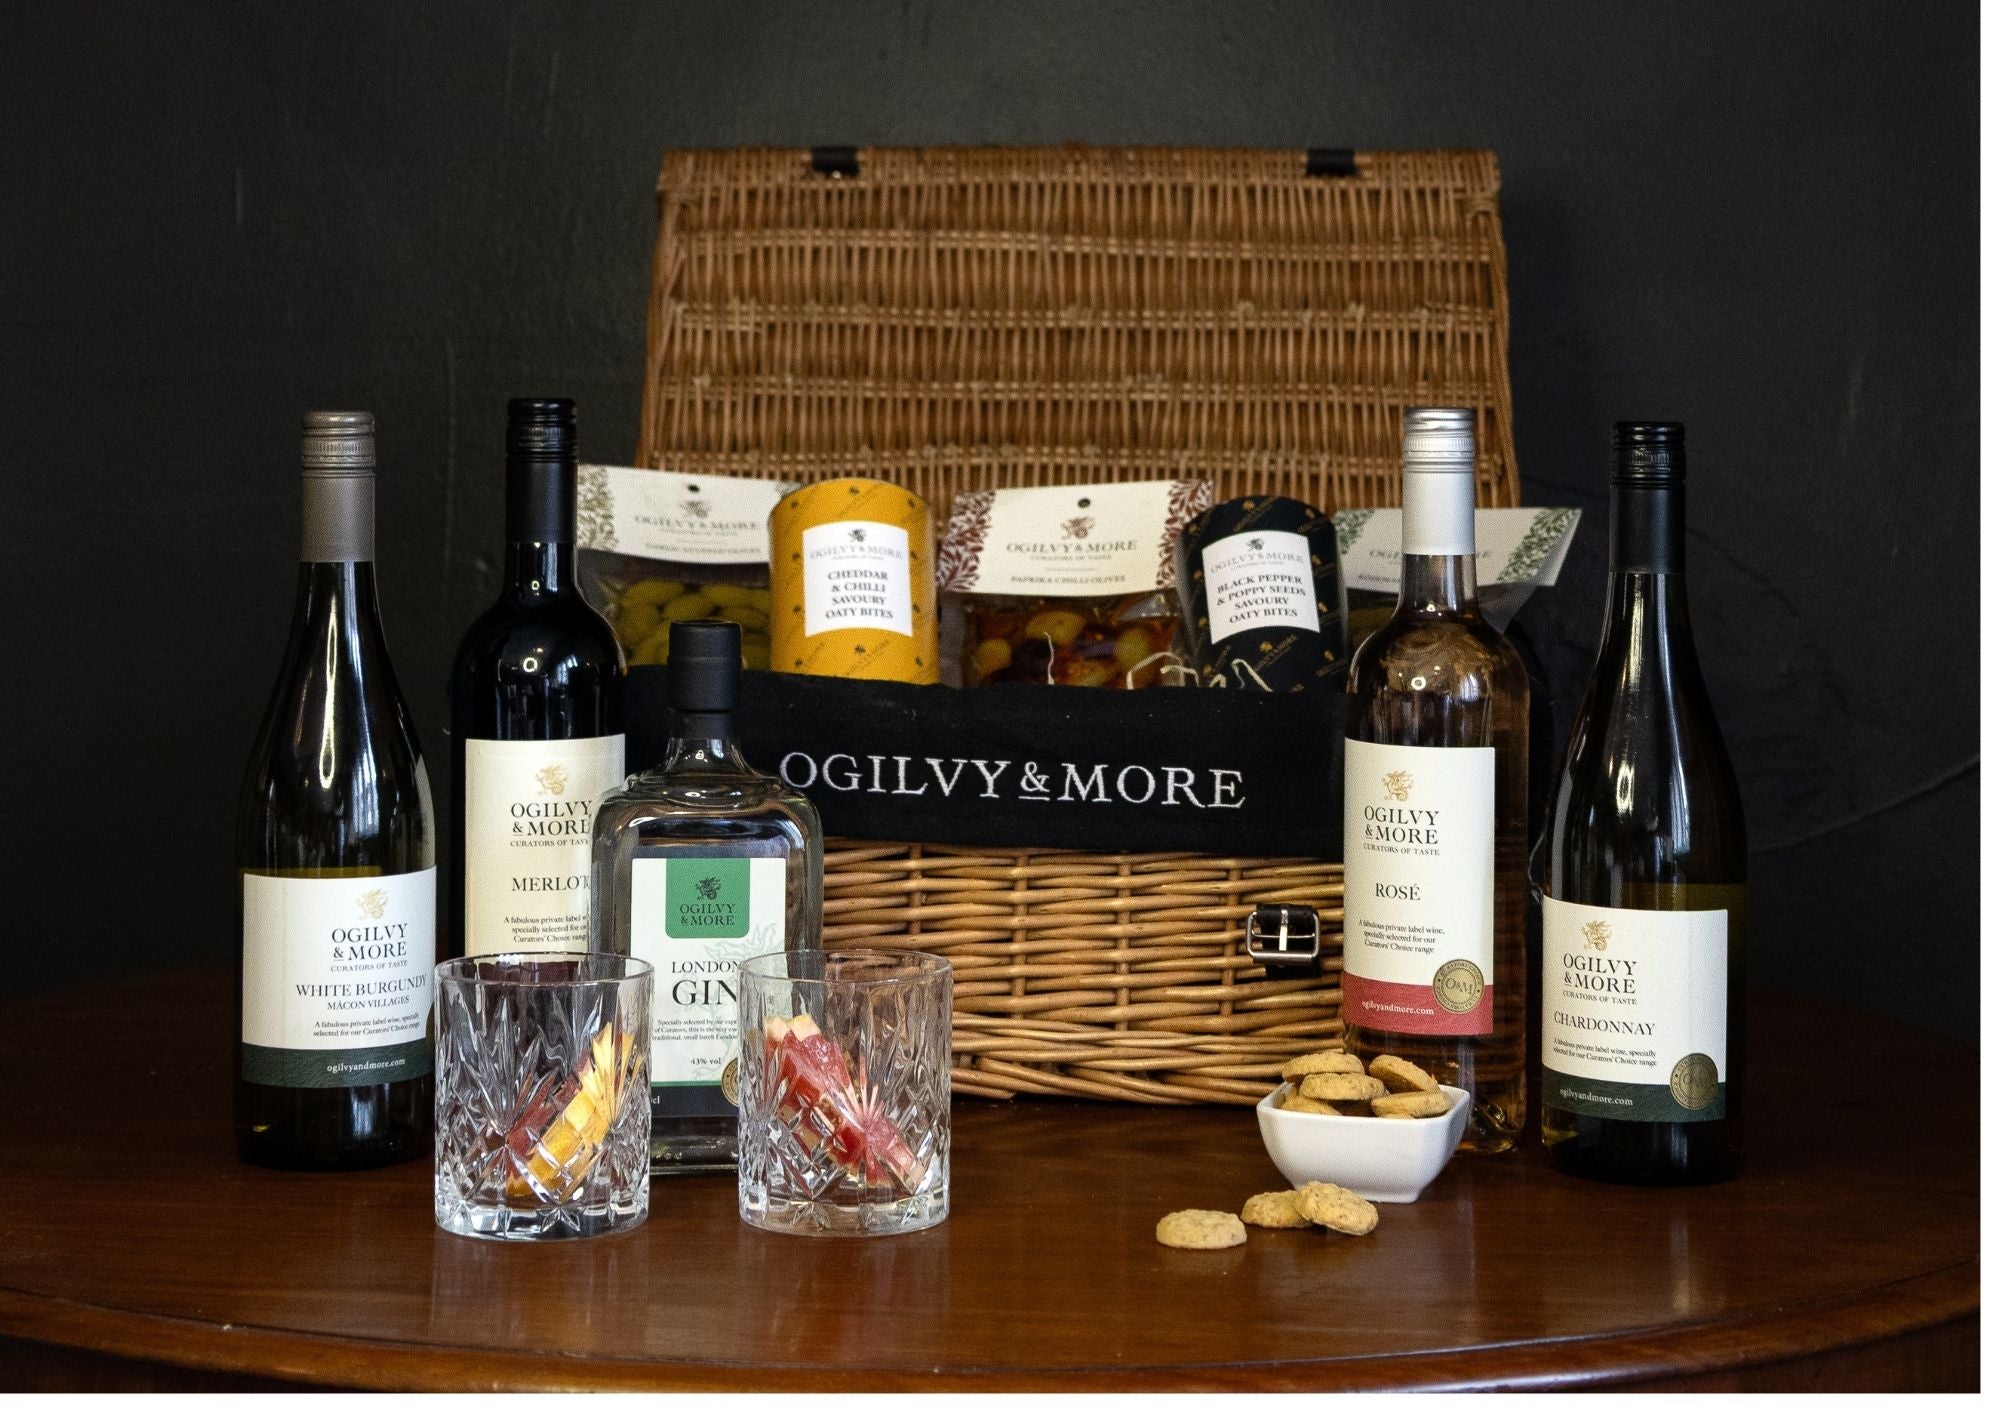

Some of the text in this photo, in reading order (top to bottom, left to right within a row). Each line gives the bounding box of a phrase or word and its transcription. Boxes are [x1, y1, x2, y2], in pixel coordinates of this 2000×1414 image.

[810, 545, 857, 560] OGILVY
[867, 545, 903, 559] MORE
[1006, 543, 1073, 554] OGILVY
[1085, 540, 1138, 553] MORE
[1265, 551, 1305, 564] MORE
[828, 570, 888, 580] CHEDDAR
[832, 583, 886, 592] & CHILLI
[1217, 574, 1303, 594] BLACK PEPPER
[832, 594, 887, 605] SAVOURY
[1216, 585, 1307, 606] & POPPY SEEDS
[1235, 596, 1289, 609] SAVOURY
[826, 607, 894, 619] OATY BITES
[1229, 608, 1298, 624] OATY BITES
[780, 751, 1247, 809] OGILVY & MORE
[510, 800, 593, 818] OGILVY
[1364, 805, 1440, 826] OGILVY
[526, 819, 591, 836] MORE
[1375, 826, 1439, 845] MORE
[510, 838, 590, 848] CURATORS OF TAST
[1363, 843, 1440, 856] CURATORS OF TASTE
[511, 875, 591, 892] MERLOT
[1375, 882, 1421, 902] ROSÉ
[679, 903, 737, 914] OGILVY
[504, 916, 510, 924] A
[511, 916, 540, 924] fabulous
[540, 916, 564, 925] private
[565, 914, 581, 923] label
[690, 915, 735, 926] MORE
[331, 923, 408, 943] OGILVY
[511, 926, 540, 935] specially
[542, 924, 569, 933] selected
[569, 924, 579, 932] for
[1363, 930, 1385, 940] specially
[1386, 933, 1411, 942] selected
[1412, 935, 1422, 943] for
[1385, 924, 1407, 933] private
[1408, 925, 1425, 934] label
[1425, 927, 1445, 936] wine,
[572, 934, 587, 942] rang
[348, 942, 407, 961] MORE
[1390, 942, 1413, 952] Choice
[1414, 946, 1435, 955] range
[330, 960, 408, 973] CURATORS OF TASTE
[672, 960, 740, 974] LONDON
[1563, 953, 1638, 976] OGILVY
[296, 974, 428, 998] WHITE BURGUNDY
[1574, 973, 1636, 994] MORE
[672, 979, 738, 1007] GIN
[1562, 990, 1638, 1005] CURATORS OF TASTE
[368, 996, 410, 1009] VILLAGES
[1361, 999, 1435, 1016] ogilvyandmore.com
[321, 1020, 349, 1028] fabulous
[350, 1020, 372, 1029] private
[372, 1016, 387, 1026] label
[387, 1017, 401, 1025] wine,
[657, 1018, 682, 1027] Specially
[683, 1018, 706, 1026] selected
[706, 1018, 713, 1027] by
[1554, 1011, 1656, 1036] CHARDONNAY
[313, 1029, 339, 1037] selected
[340, 1028, 349, 1037] for
[391, 1024, 408, 1032] Choice
[1575, 1043, 1594, 1052] private
[1595, 1045, 1610, 1054] label
[1610, 1048, 1628, 1056] wine,
[1628, 1049, 1657, 1059] specially
[326, 1058, 406, 1074] ogilvyandmore.com
[709, 1057, 722, 1065] vol
[1614, 1056, 1638, 1065] Choice
[1638, 1059, 1657, 1068] range
[1560, 1087, 1634, 1107] ogilvyandmore.com
